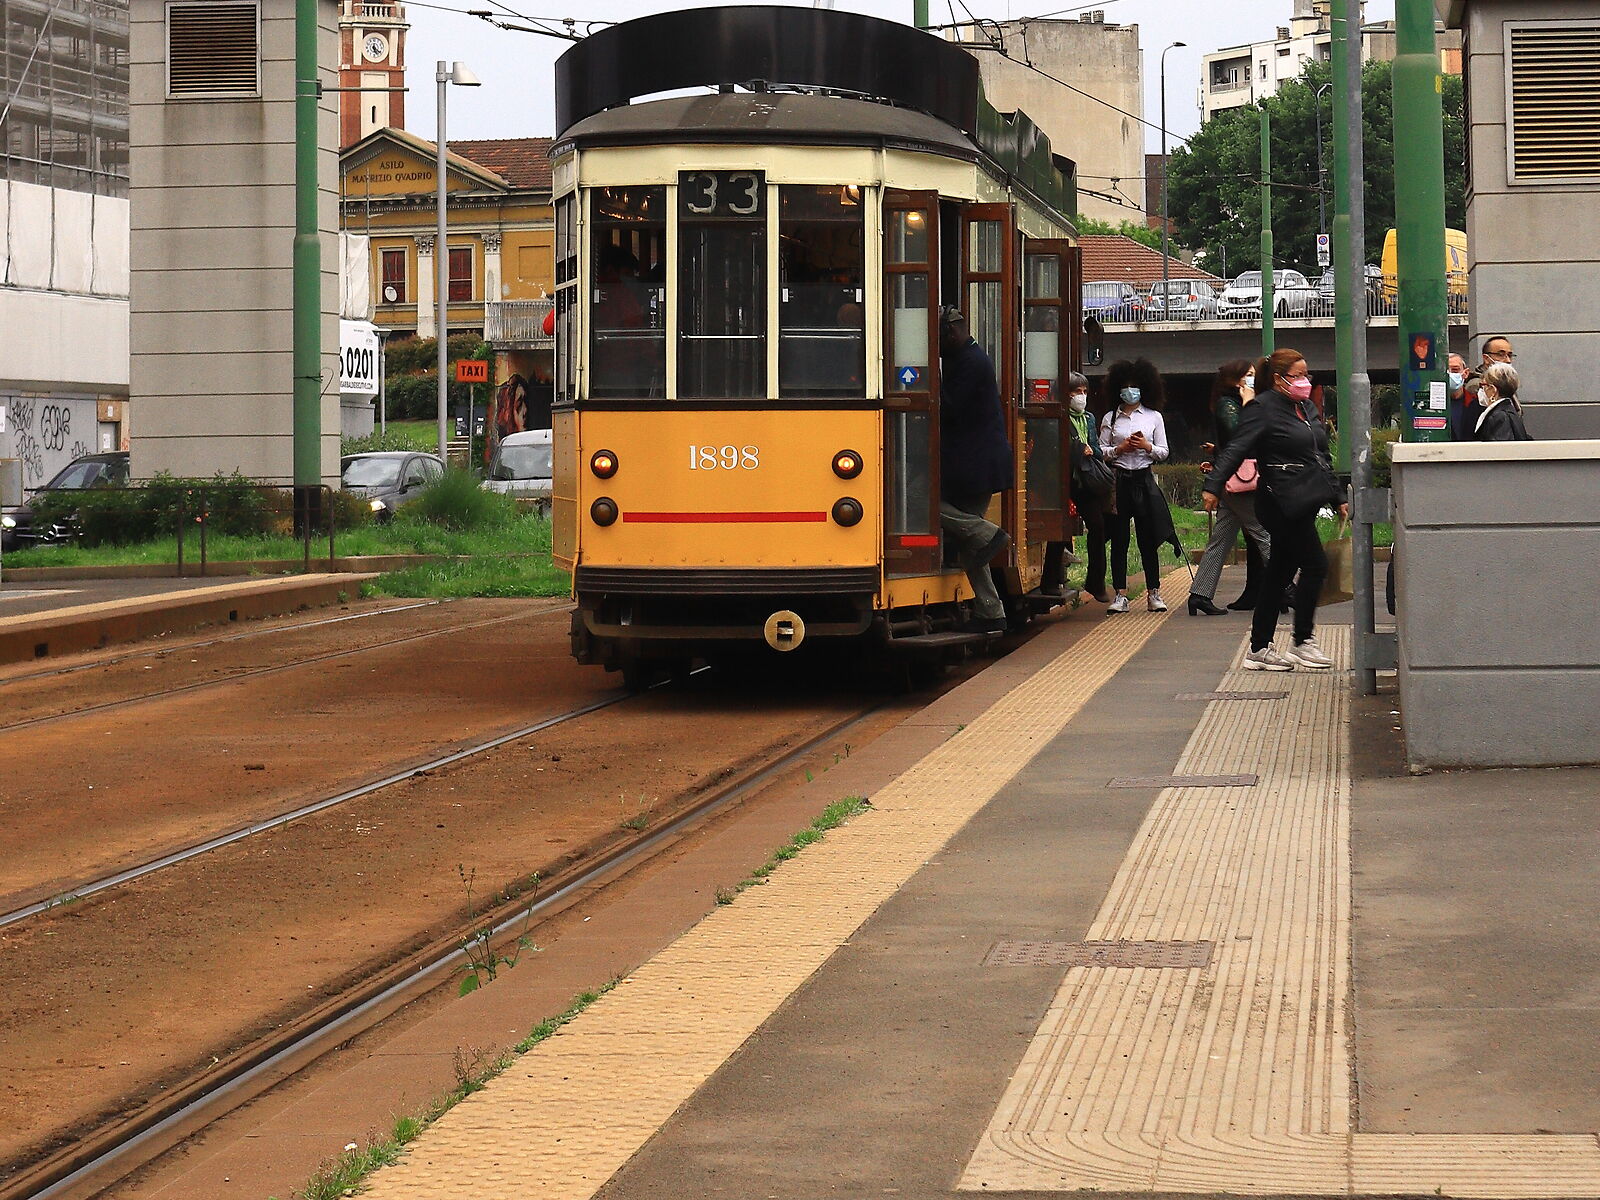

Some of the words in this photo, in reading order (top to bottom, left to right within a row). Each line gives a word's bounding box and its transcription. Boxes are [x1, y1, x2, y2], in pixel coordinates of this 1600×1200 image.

[379, 161, 405, 170] ASILO
[395, 171, 432, 183] QVADRIO
[687, 173, 759, 215] 33
[346, 346, 374, 380] 0201
[461, 365, 484, 377] TAXI
[689, 445, 760, 471] 1898
